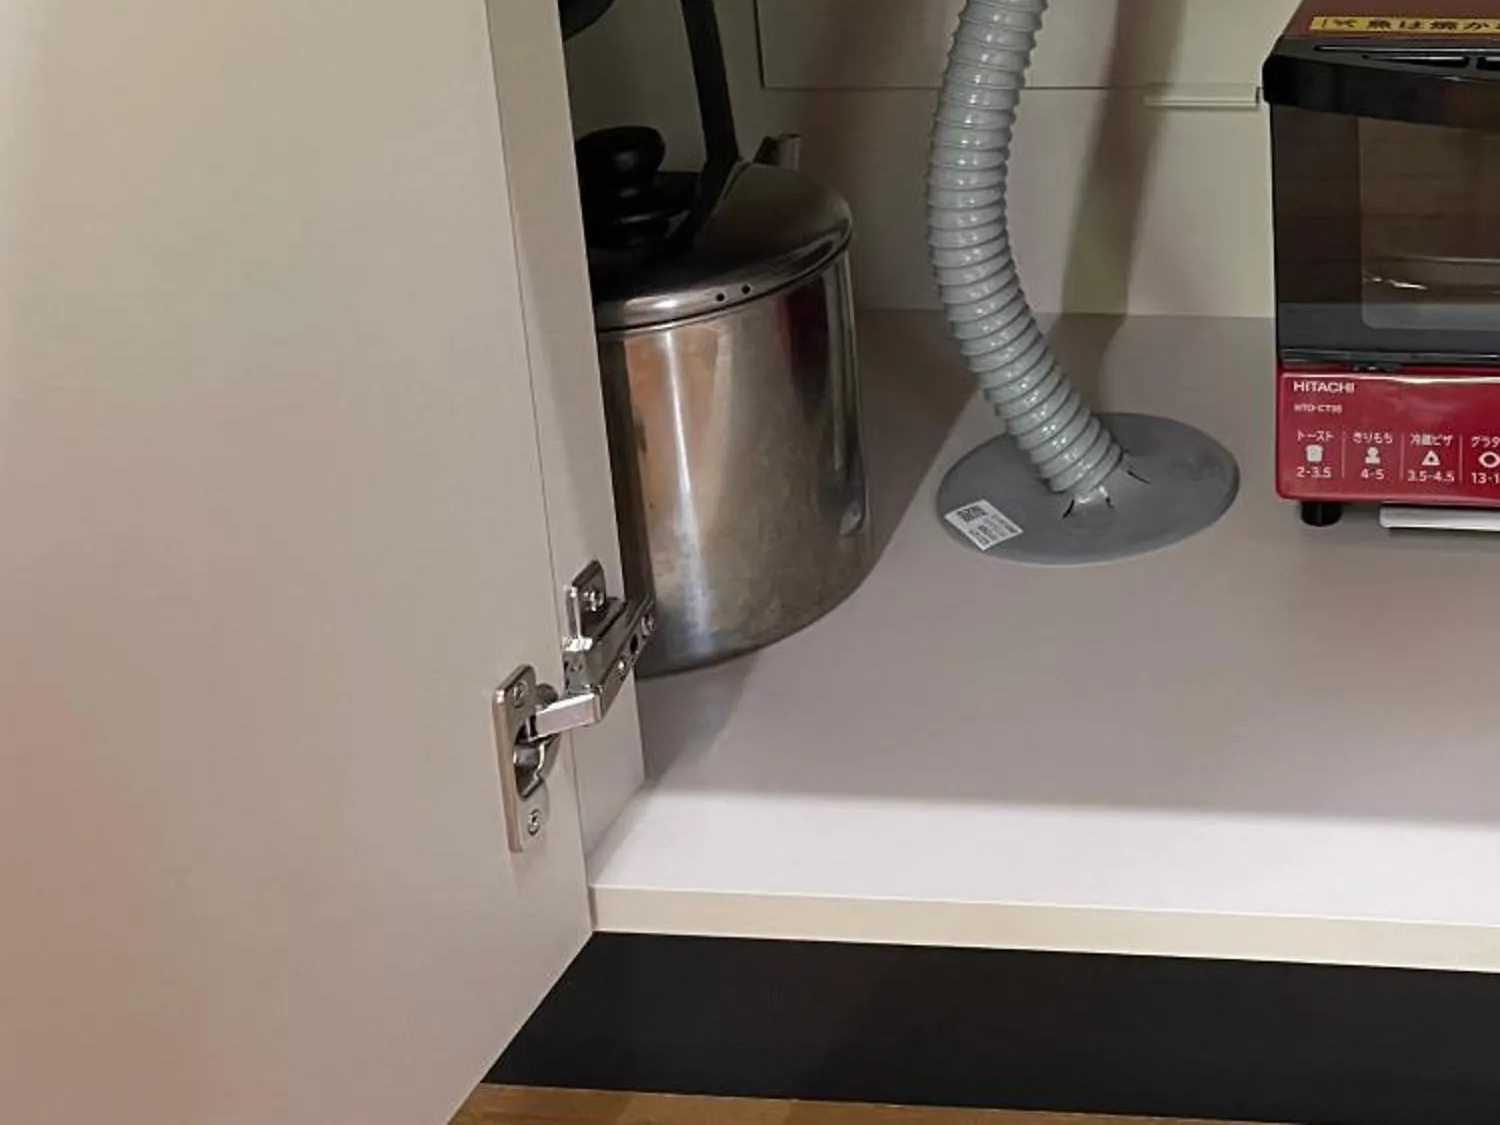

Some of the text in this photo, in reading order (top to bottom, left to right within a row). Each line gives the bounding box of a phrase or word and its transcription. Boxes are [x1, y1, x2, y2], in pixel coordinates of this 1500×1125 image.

[1293, 380, 1355, 393] HITACHI
[1297, 430, 1335, 442] トースト
[1353, 431, 1393, 444] きりもち
